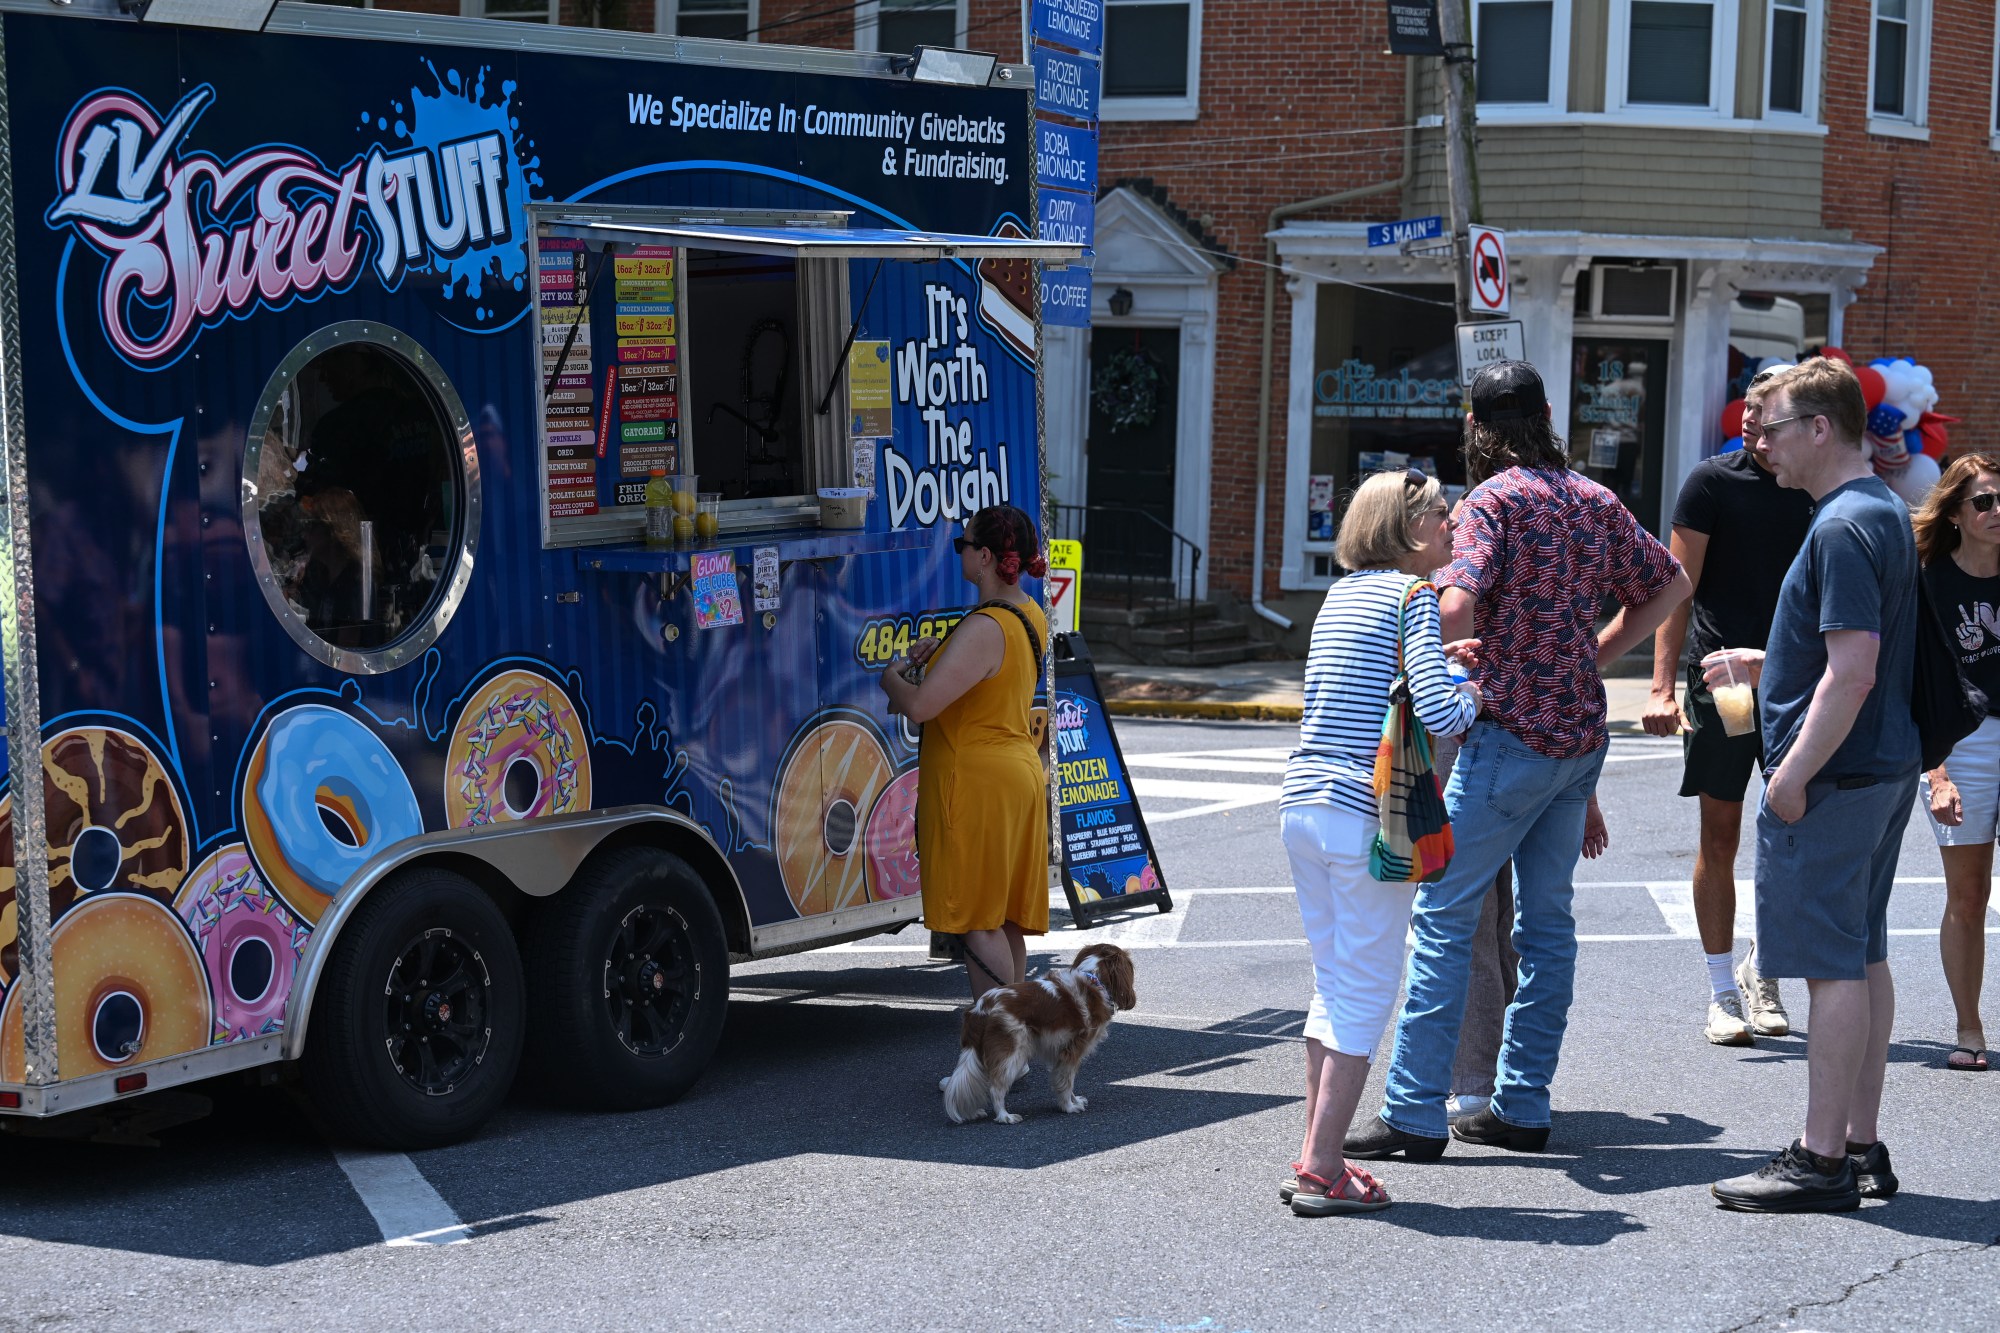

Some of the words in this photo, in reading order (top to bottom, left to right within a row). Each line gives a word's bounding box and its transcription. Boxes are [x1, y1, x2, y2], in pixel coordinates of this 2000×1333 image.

[1048, 10, 1090, 40] LEMONADE
[1048, 59, 1082, 86] FROZEN
[1039, 78, 1089, 110] LEMONADE
[628, 93, 663, 126] We
[670, 96, 771, 132] Specialize
[778, 103, 796, 133] In
[804, 104, 915, 143] Community
[919, 112, 1006, 145] Givebacks
[1044, 131, 1070, 156] BOBA
[881, 147, 898, 176] &
[903, 147, 1009, 185] Fundraising.
[1048, 199, 1076, 222] DIRTY
[1382, 226, 1390, 243] S
[1393, 221, 1427, 242] MAIN
[1427, 219, 1436, 230] ST
[106, 152, 397, 359] Sweet
[366, 134, 506, 280] STUFF
[556, 256, 572, 266] BAG
[616, 265, 632, 274] 16oz
[644, 265, 661, 274] 32oz
[540, 275, 556, 284] RGE
[558, 274, 573, 284] BAG
[558, 292, 574, 300] BOX
[1052, 284, 1086, 308] COFFEE
[618, 322, 634, 330] 16oz
[646, 321, 662, 330] 32oz
[1473, 328, 1508, 343] EXCEPT
[1477, 347, 1508, 361] LOCAL
[642, 366, 670, 374] COFFEE
[896, 340, 988, 406] Worth
[552, 392, 576, 400] GLAZED
[622, 383, 637, 392] 16oz
[648, 382, 664, 391] 32oz
[576, 406, 590, 414] CHIP
[574, 420, 590, 428] ROLL
[624, 426, 664, 436] GATORADE
[550, 434, 582, 442] SPRINKLES
[576, 476, 594, 484] GLAZE
[619, 484, 648, 494] FRIE
[576, 490, 596, 498] GLAZE
[698, 556, 730, 576] GLOWY
[758, 566, 774, 574] DIRTY
[694, 576, 711, 596] ICE
[712, 572, 736, 590] CUBES
[720, 598, 734, 618] $2
[860, 618, 962, 662] 484-83
[1961, 652, 1980, 664] PEACE
[1058, 758, 1109, 786] FROZEN
[1060, 780, 1120, 806] LEMONADE!
[1076, 808, 1116, 828] FLAVORS
[1066, 830, 1092, 842] RASPBERRY
[1096, 828, 1108, 837] BLUE
[1108, 824, 1133, 835] RASPBERRY
[1068, 842, 1086, 852] CHERRY
[1090, 836, 1120, 848] STRAWBERRY
[1122, 833, 1138, 842] PEACH
[1072, 850, 1097, 862] BLUEBERRY
[1101, 846, 1118, 856] MANGO
[1121, 842, 1142, 852] ORIGINAL
